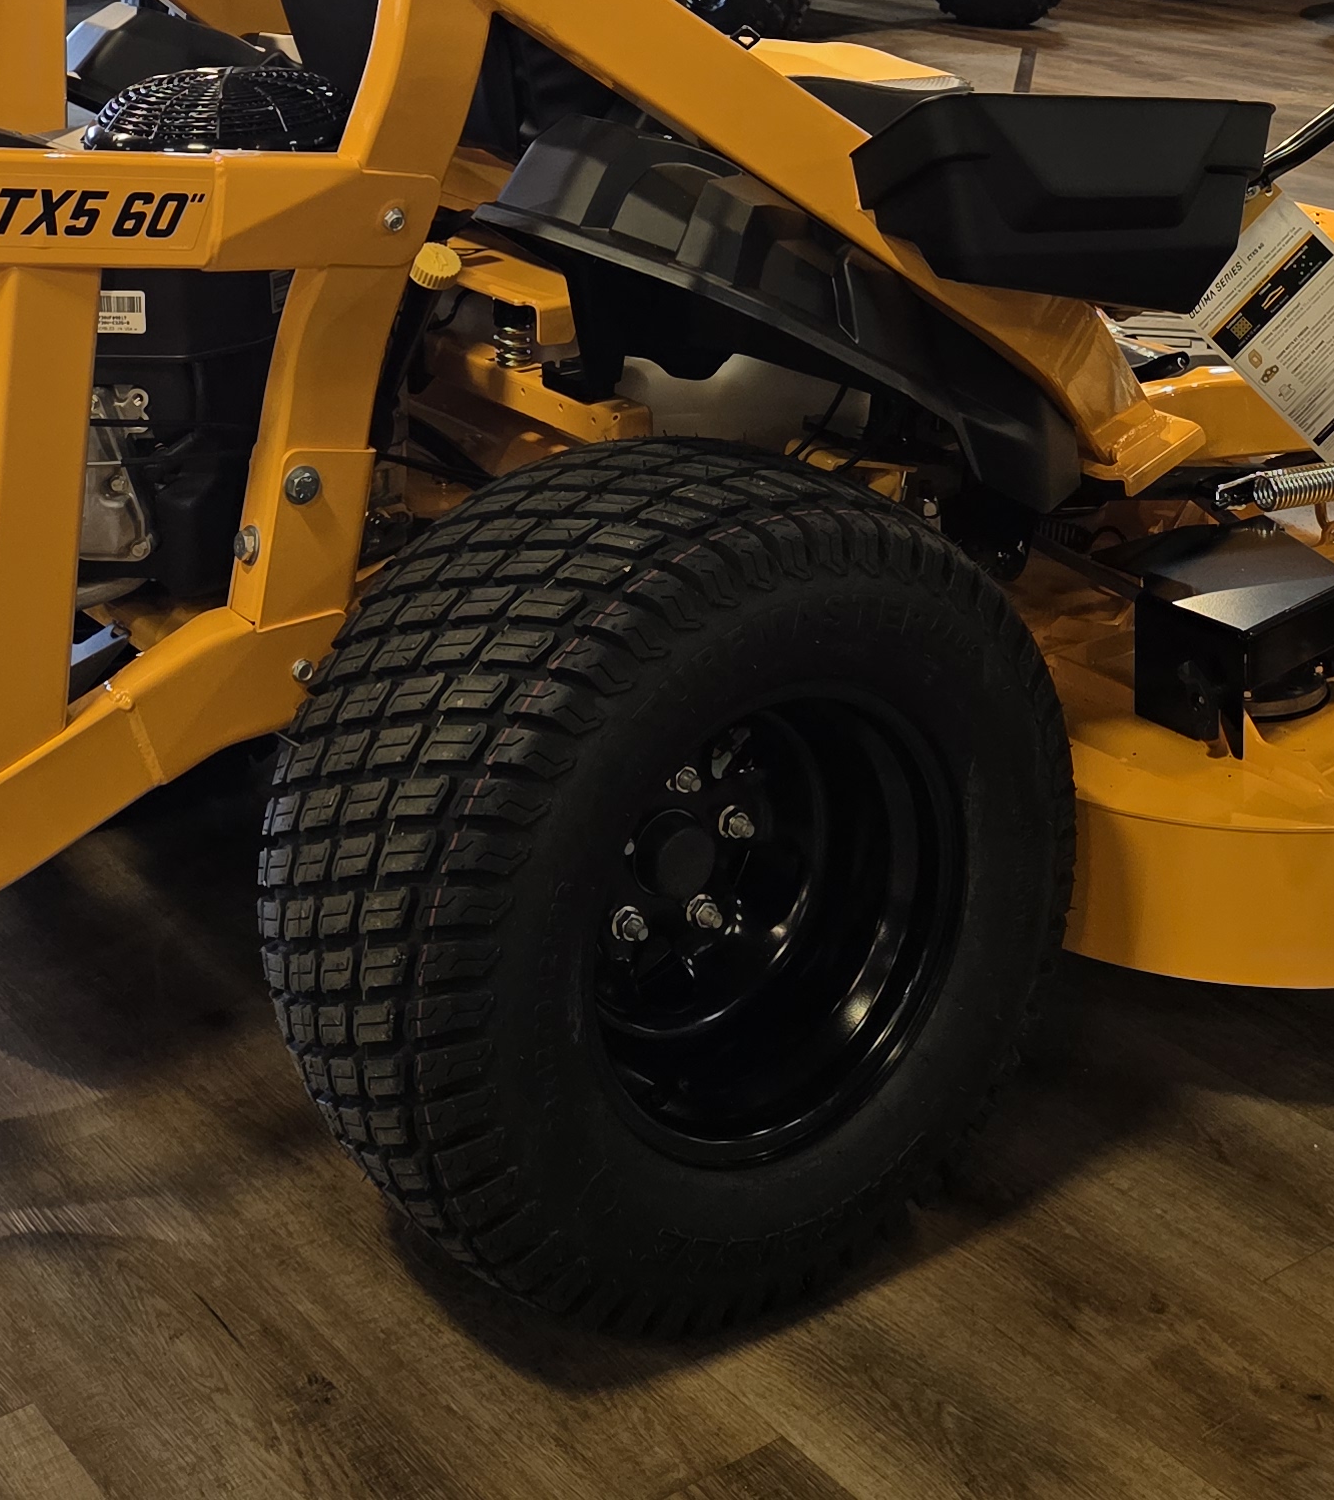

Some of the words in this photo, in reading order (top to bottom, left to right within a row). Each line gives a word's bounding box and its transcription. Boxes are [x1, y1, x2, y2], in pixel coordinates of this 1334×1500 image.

[111, 191, 206, 238] 60"
[1188, 290, 1217, 320] ULTIMA
[1215, 261, 1243, 293] SERIES
